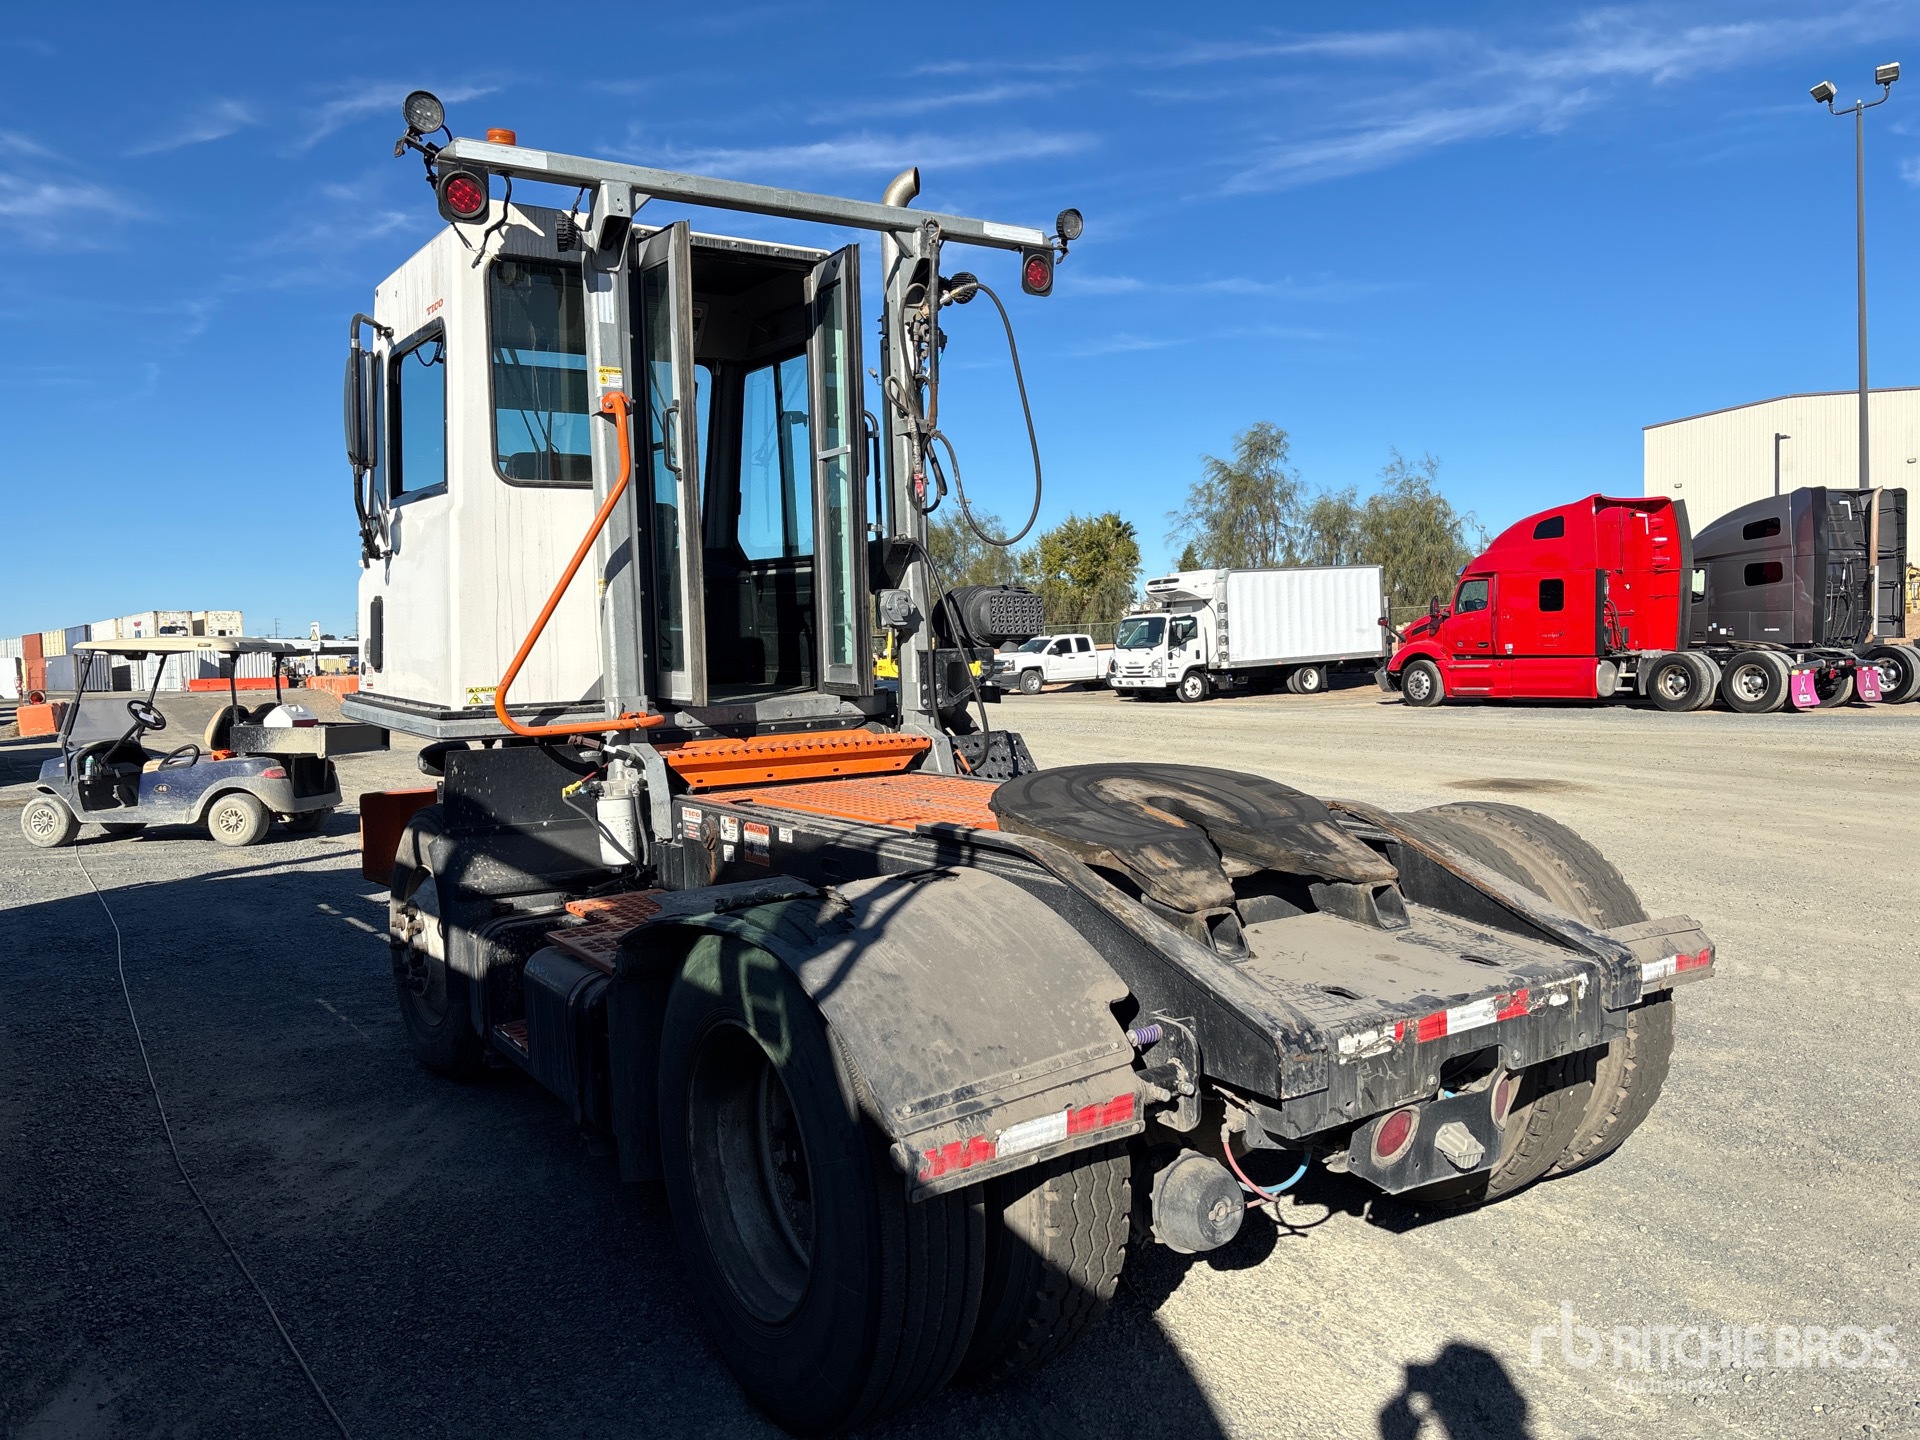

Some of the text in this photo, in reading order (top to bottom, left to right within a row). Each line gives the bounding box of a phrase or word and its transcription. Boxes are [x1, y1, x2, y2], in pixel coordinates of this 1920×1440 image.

[426, 298, 444, 316] TICO
[684, 809, 701, 818] TICO
[748, 823, 769, 836] WARNING
